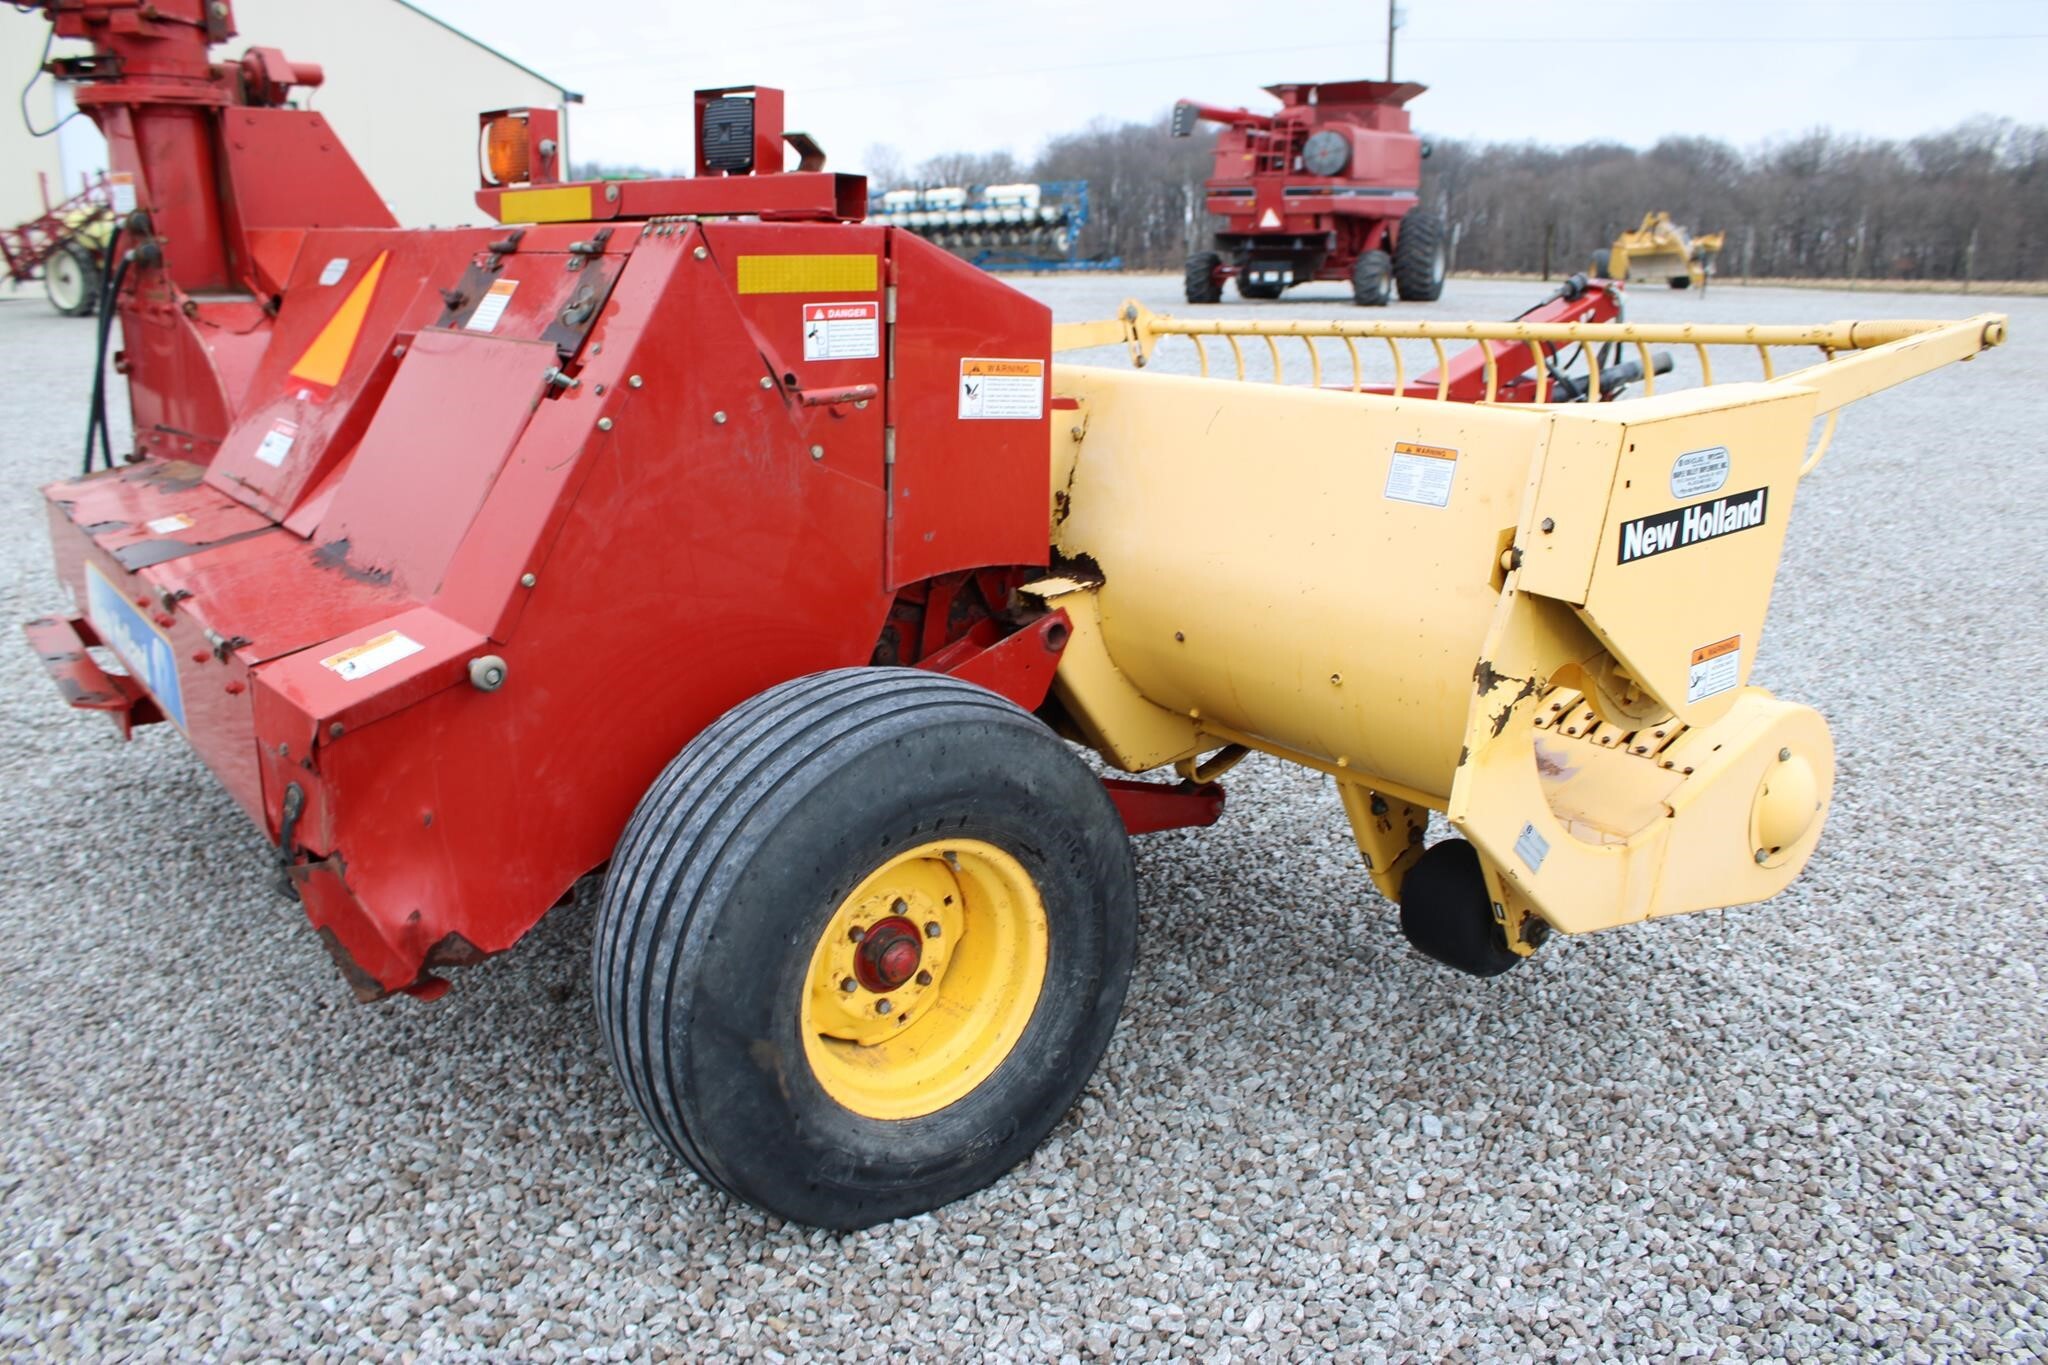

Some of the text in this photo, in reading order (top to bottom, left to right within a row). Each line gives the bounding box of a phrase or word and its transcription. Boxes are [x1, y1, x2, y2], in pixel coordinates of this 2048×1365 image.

[827, 308, 867, 319] DANGER
[987, 364, 1030, 374] WARNING
[1415, 447, 1447, 457] WARNING
[1623, 489, 1765, 561] New Holland
